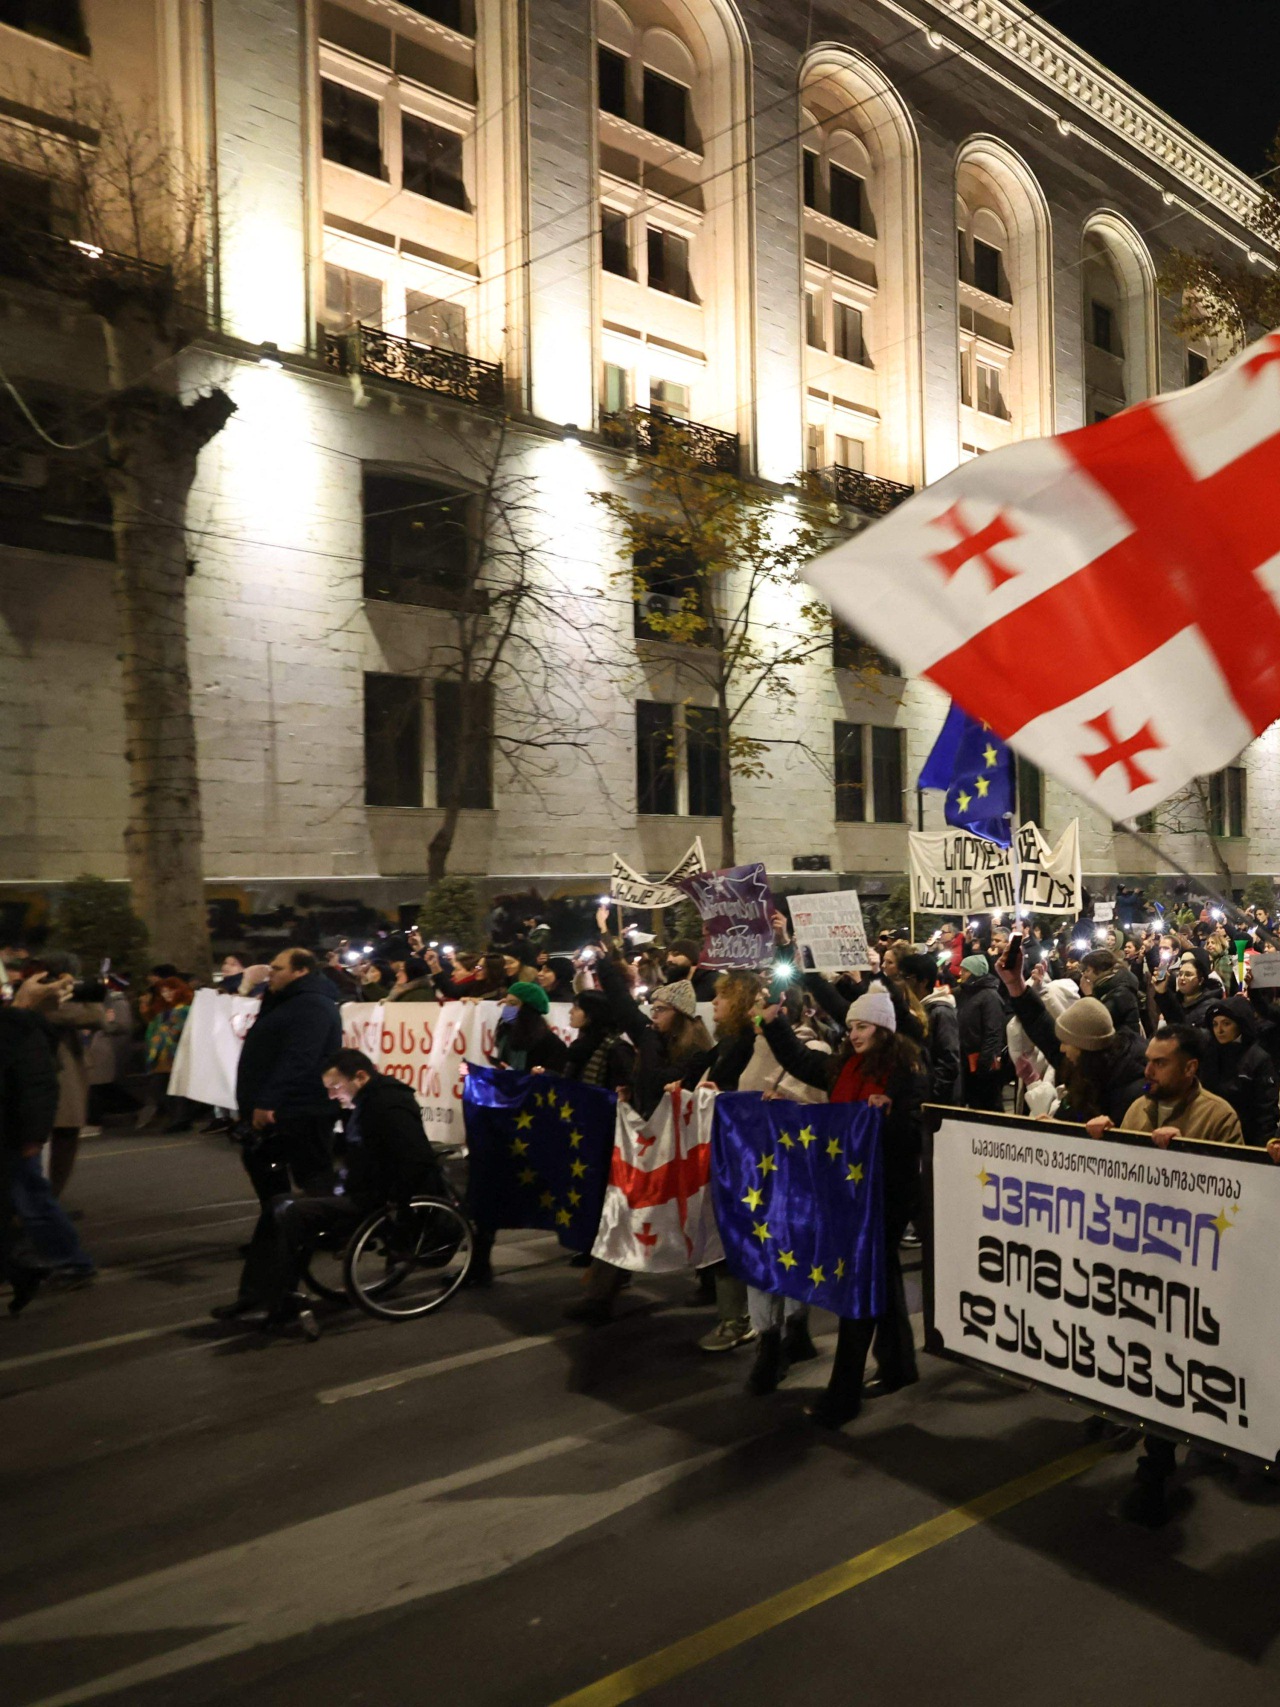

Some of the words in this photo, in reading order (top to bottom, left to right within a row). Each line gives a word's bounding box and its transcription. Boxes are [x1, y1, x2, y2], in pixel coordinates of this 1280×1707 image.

[971, 1138, 1034, 1165] სამეცნიერო
[1035, 1148, 1049, 1167] და
[1051, 1150, 1145, 1183] ტექნოლოგიური
[1147, 1166, 1242, 1200] საზოგადოება
[982, 1172, 1220, 1272] ევროპული
[978, 1234, 1220, 1346] მომავლის
[960, 1290, 1250, 1429] დასაცავად!
